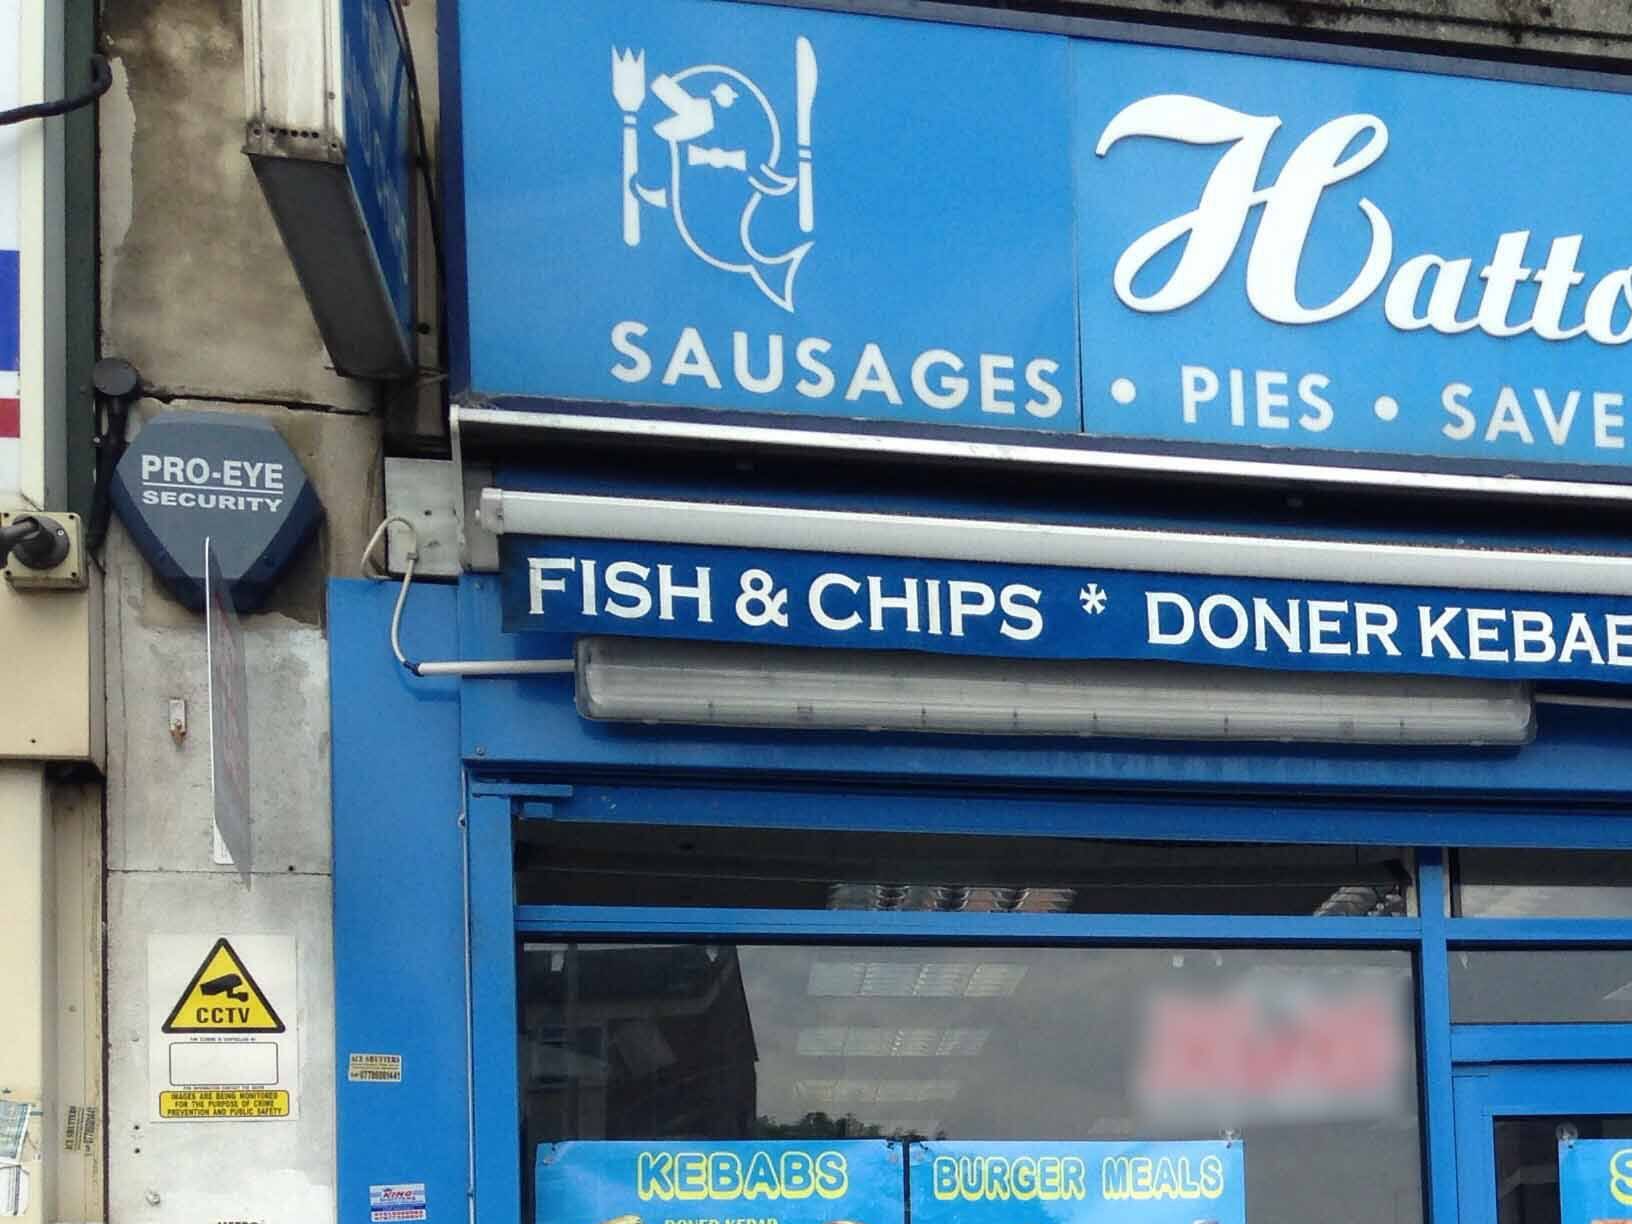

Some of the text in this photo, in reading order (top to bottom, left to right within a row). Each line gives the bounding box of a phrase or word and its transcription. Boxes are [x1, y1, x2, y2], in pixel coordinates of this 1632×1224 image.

[610, 320, 1063, 418] SAUSAGES
[1182, 364, 1334, 432] PIES
[142, 454, 283, 489] PRO-EYE
[142, 490, 283, 513] SECURITY
[526, 555, 713, 624] FISH
[735, 566, 788, 627] &
[808, 571, 1043, 641] CHIPS
[1146, 590, 1400, 657] DONER
[196, 1007, 250, 1024] CCTV
[637, 1151, 848, 1200] KEBABS
[933, 1155, 1224, 1200] BURGER MEALS
